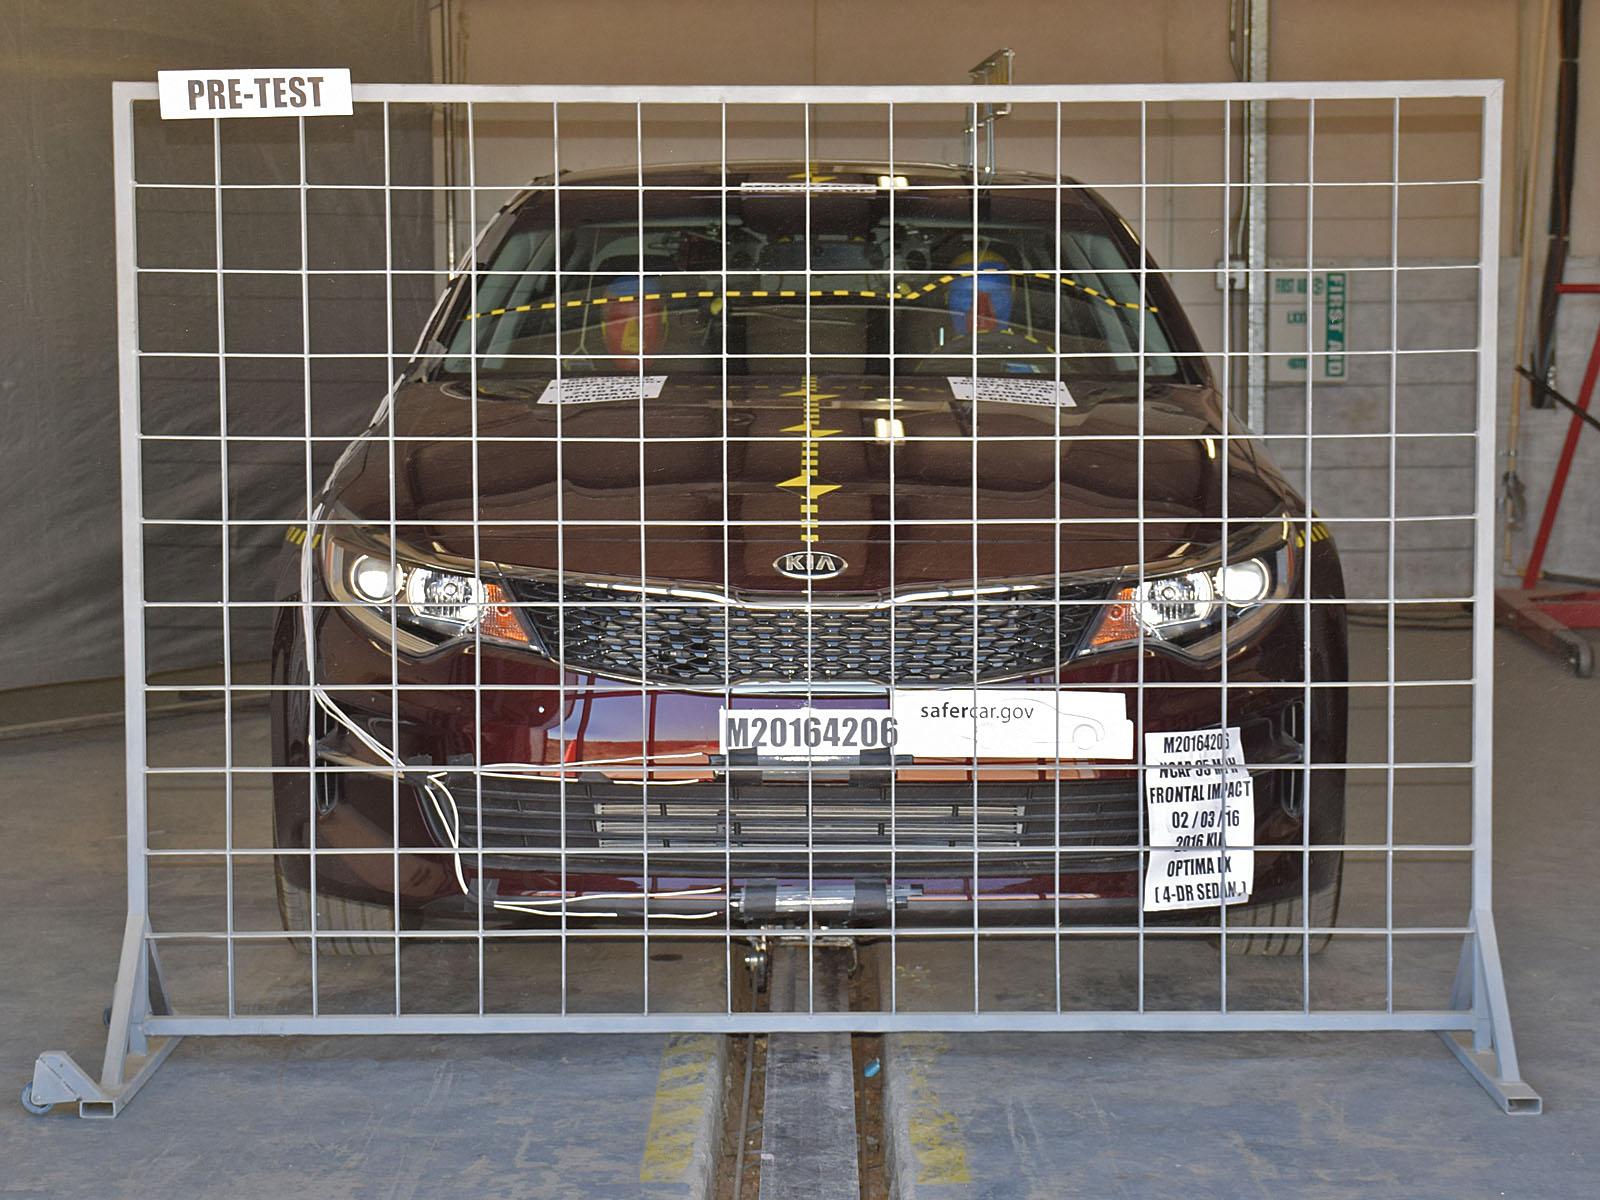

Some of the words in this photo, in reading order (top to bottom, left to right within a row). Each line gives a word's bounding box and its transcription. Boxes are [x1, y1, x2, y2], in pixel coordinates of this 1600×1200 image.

[187, 76, 324, 111] PRE-TEST
[1327, 274, 1344, 334] FIRST
[785, 554, 836, 571] KIA
[920, 701, 1034, 723] safercar.gov
[727, 717, 898, 748] M20164206
[1149, 784, 1205, 804] FRONTAL
[1167, 857, 1215, 878] OPTIMA
